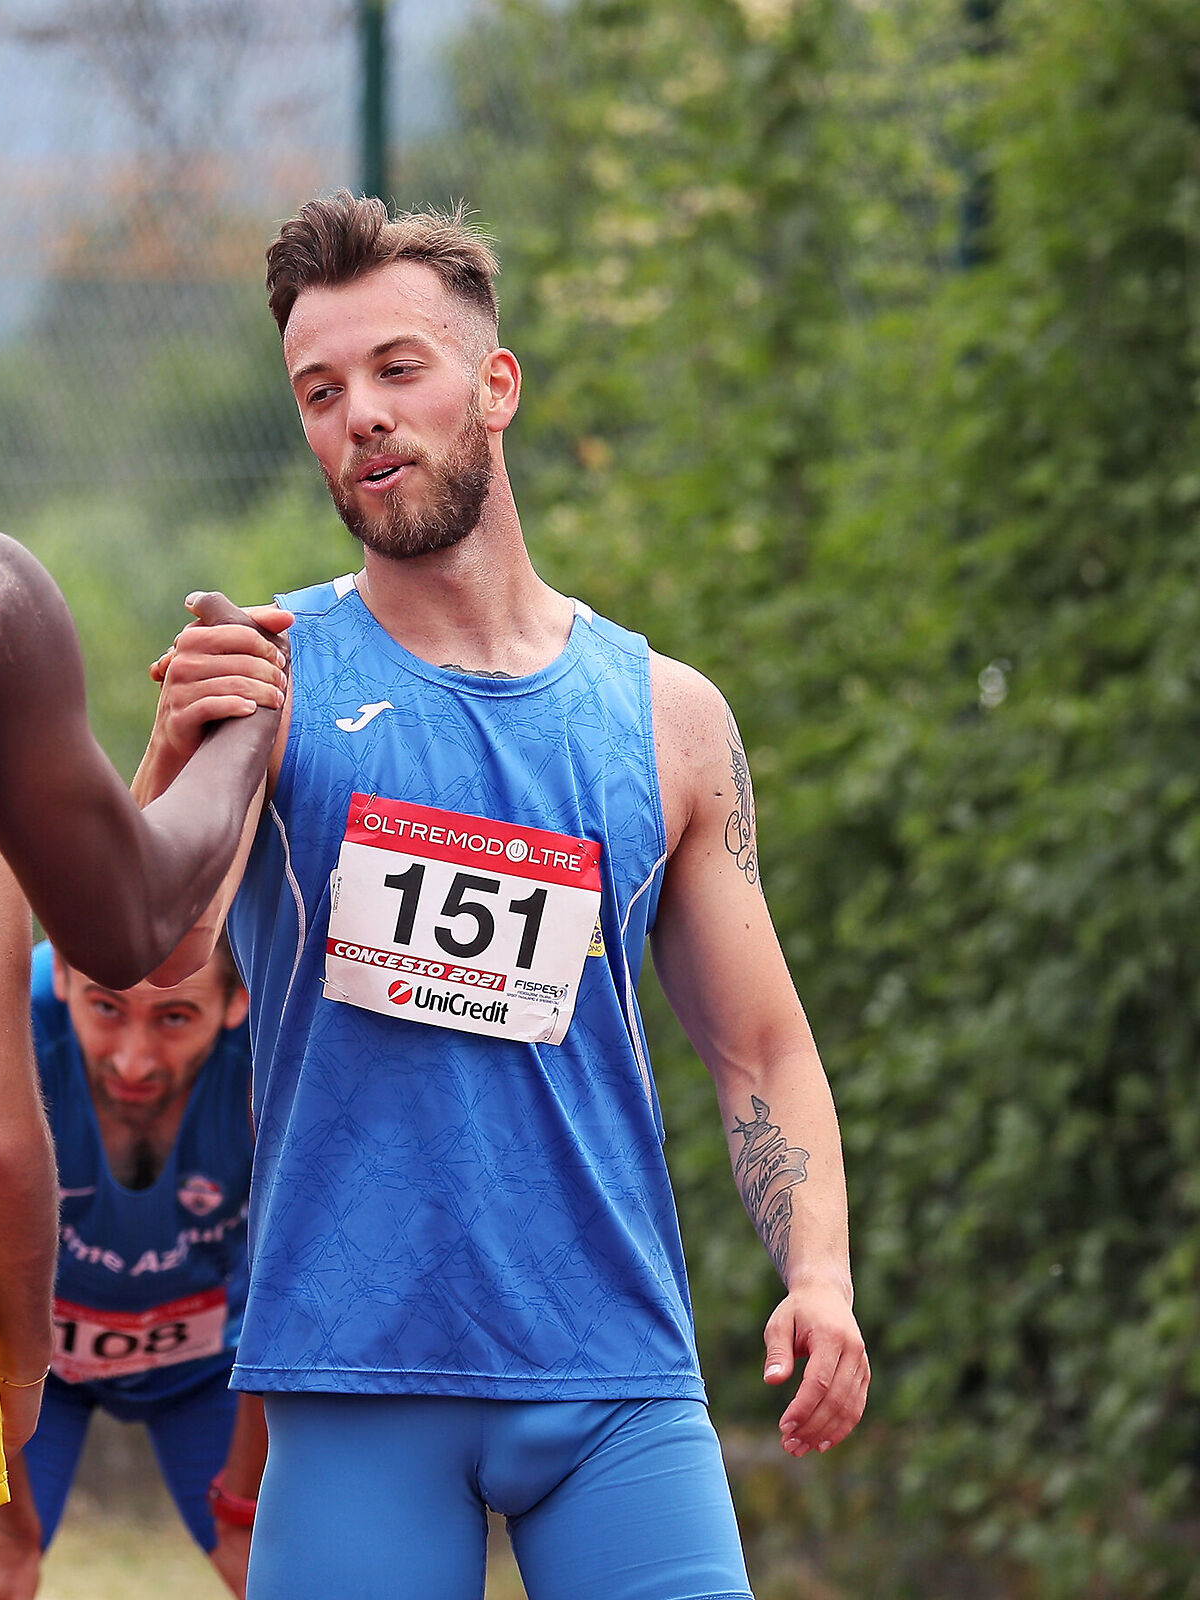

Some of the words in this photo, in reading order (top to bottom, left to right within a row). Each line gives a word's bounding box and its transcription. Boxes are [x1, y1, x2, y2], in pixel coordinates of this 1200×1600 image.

[383, 862, 549, 970] 151
[334, 942, 445, 977] CONCESIO
[447, 967, 503, 989] 2021
[414, 985, 509, 1025] UniCredit
[514, 980, 558, 997] FISPES
[53, 1320, 189, 1360] 108
